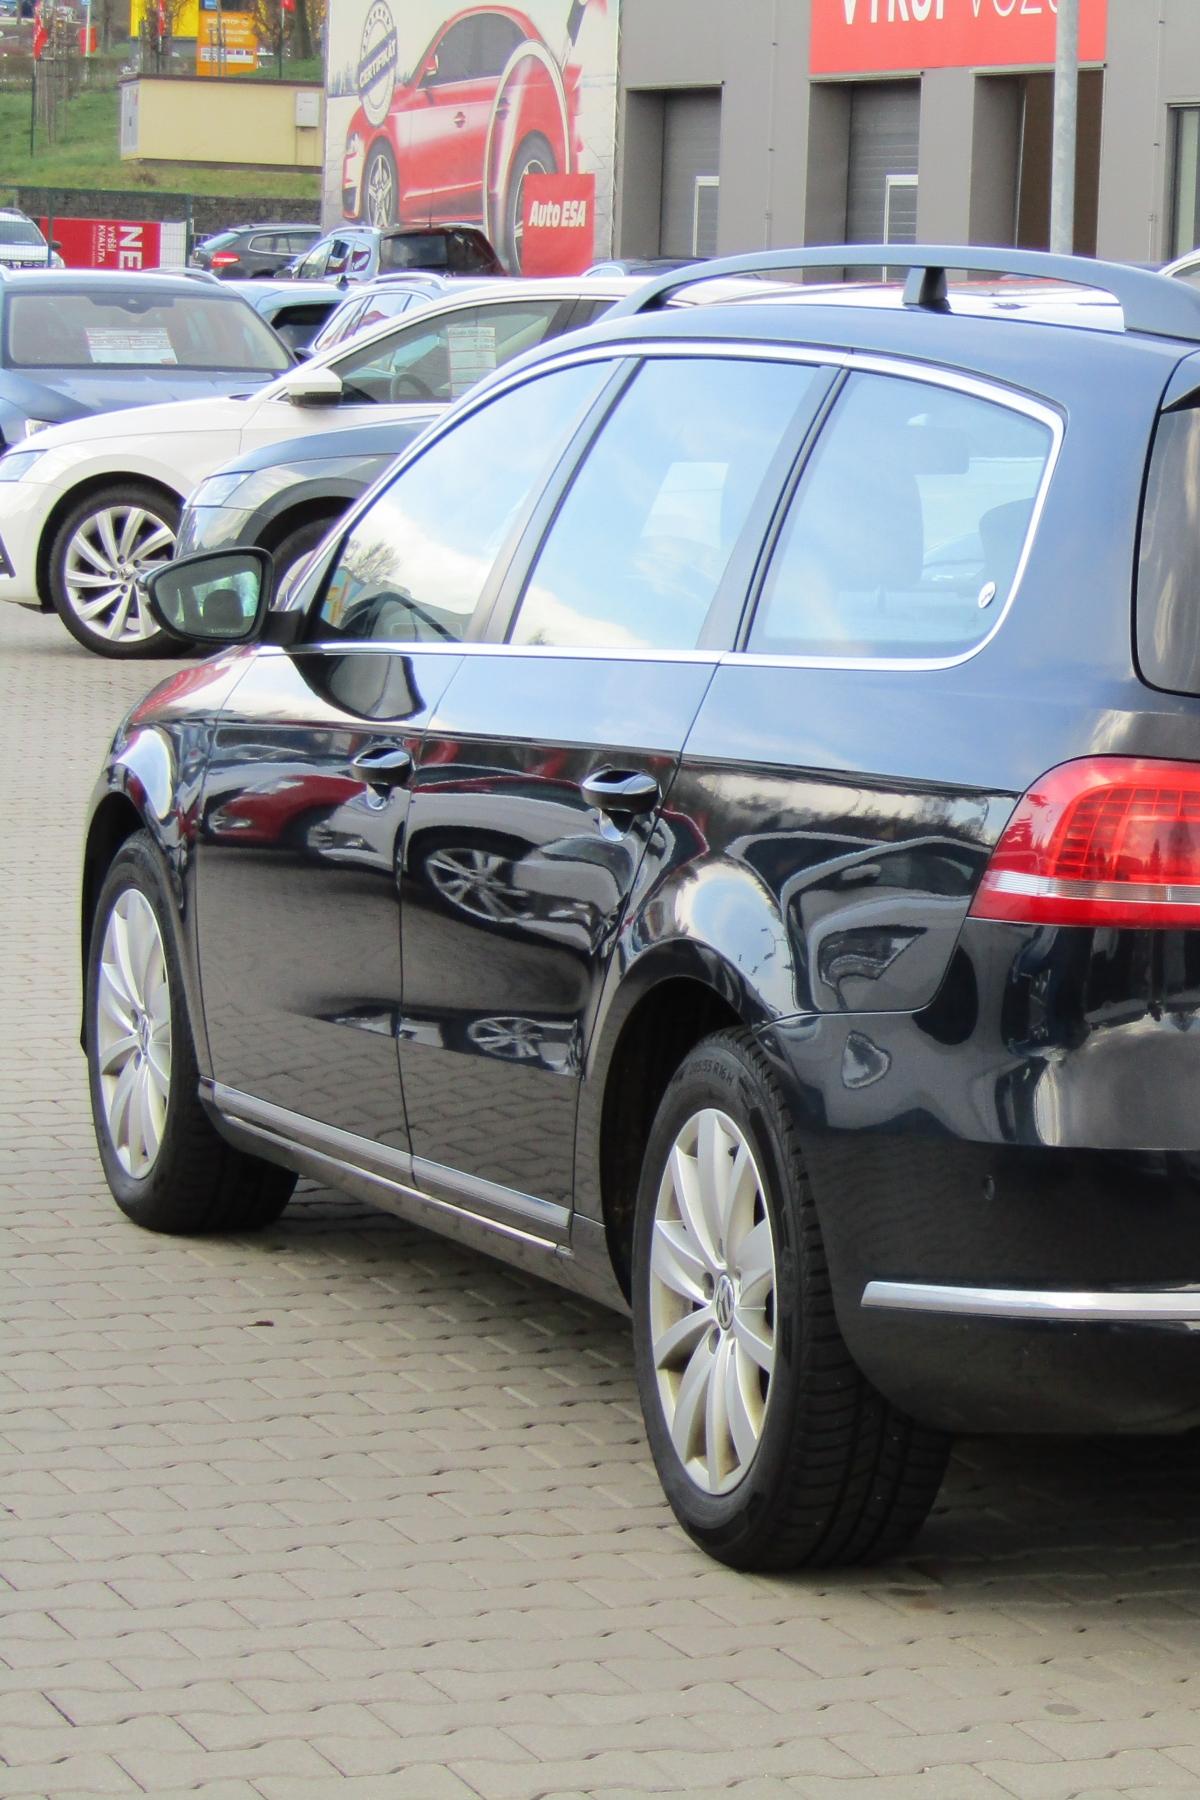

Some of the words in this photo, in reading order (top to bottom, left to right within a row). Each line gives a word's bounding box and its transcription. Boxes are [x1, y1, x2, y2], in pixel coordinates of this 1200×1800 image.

[527, 200, 560, 228] Auto
[560, 200, 587, 228] ESA
[97, 224, 106, 263] KVALITA
